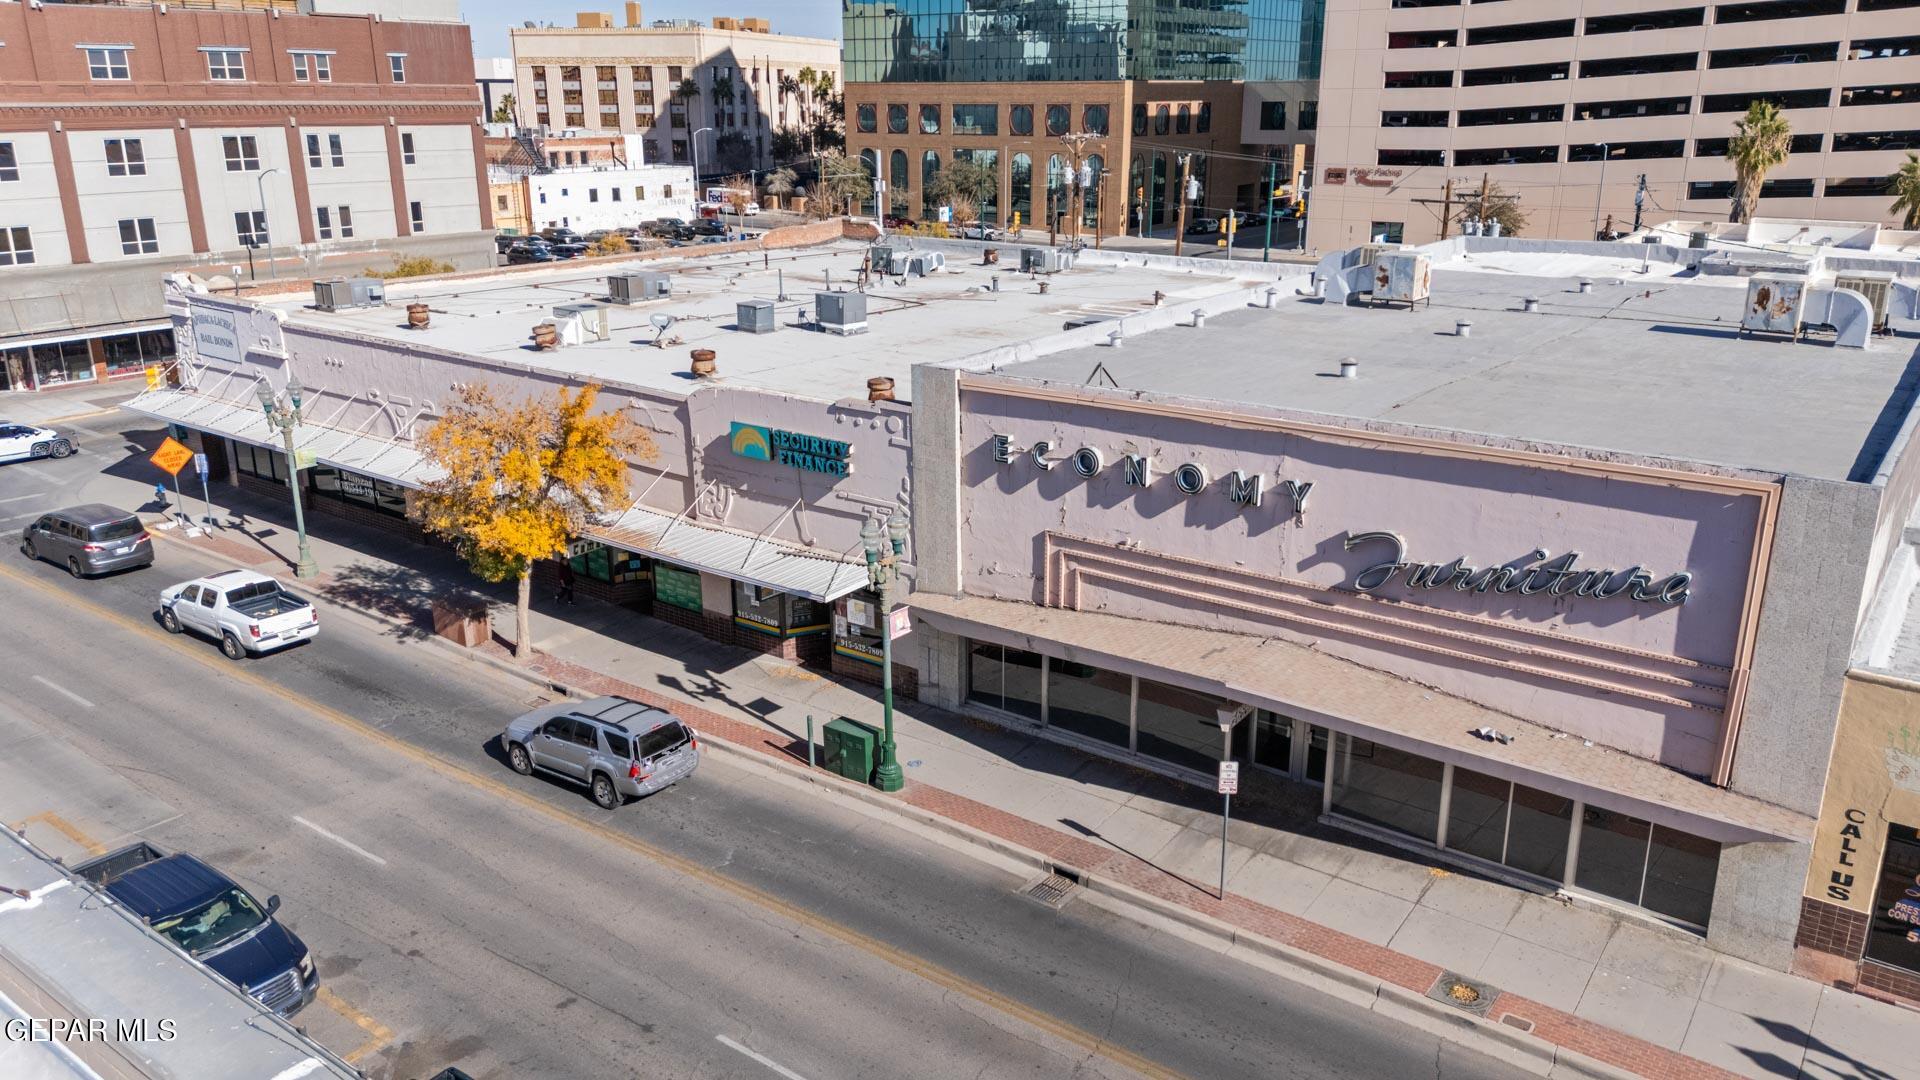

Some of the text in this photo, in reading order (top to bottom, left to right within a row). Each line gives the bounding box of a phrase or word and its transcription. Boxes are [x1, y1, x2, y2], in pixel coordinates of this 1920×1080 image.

[200, 333, 234, 348] BAIL BONDS
[773, 430, 850, 458] SECURITY
[778, 449, 849, 478] FINANCE
[992, 433, 1315, 514] ECONOMY
[1344, 530, 1692, 607] Furniture
[1826, 808, 1866, 902] CALL US
[1887, 908, 1908, 922] CON
